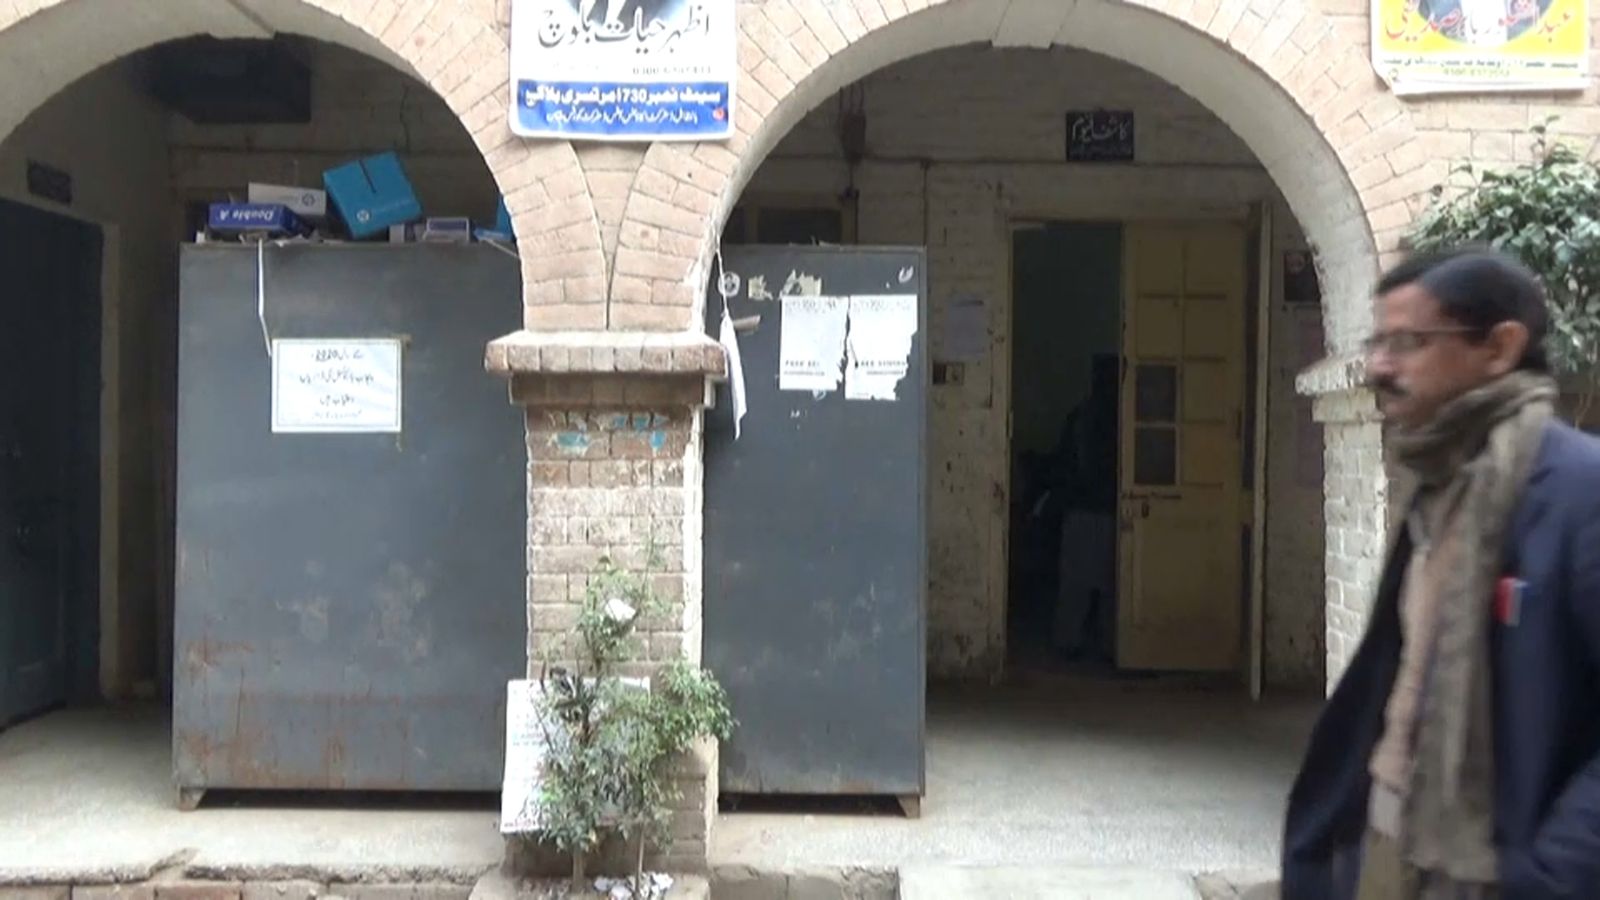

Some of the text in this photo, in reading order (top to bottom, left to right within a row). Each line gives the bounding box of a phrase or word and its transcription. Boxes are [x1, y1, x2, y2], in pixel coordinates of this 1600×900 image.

[595, 6, 666, 54] حیات
[219, 208, 275, 222] Double A
